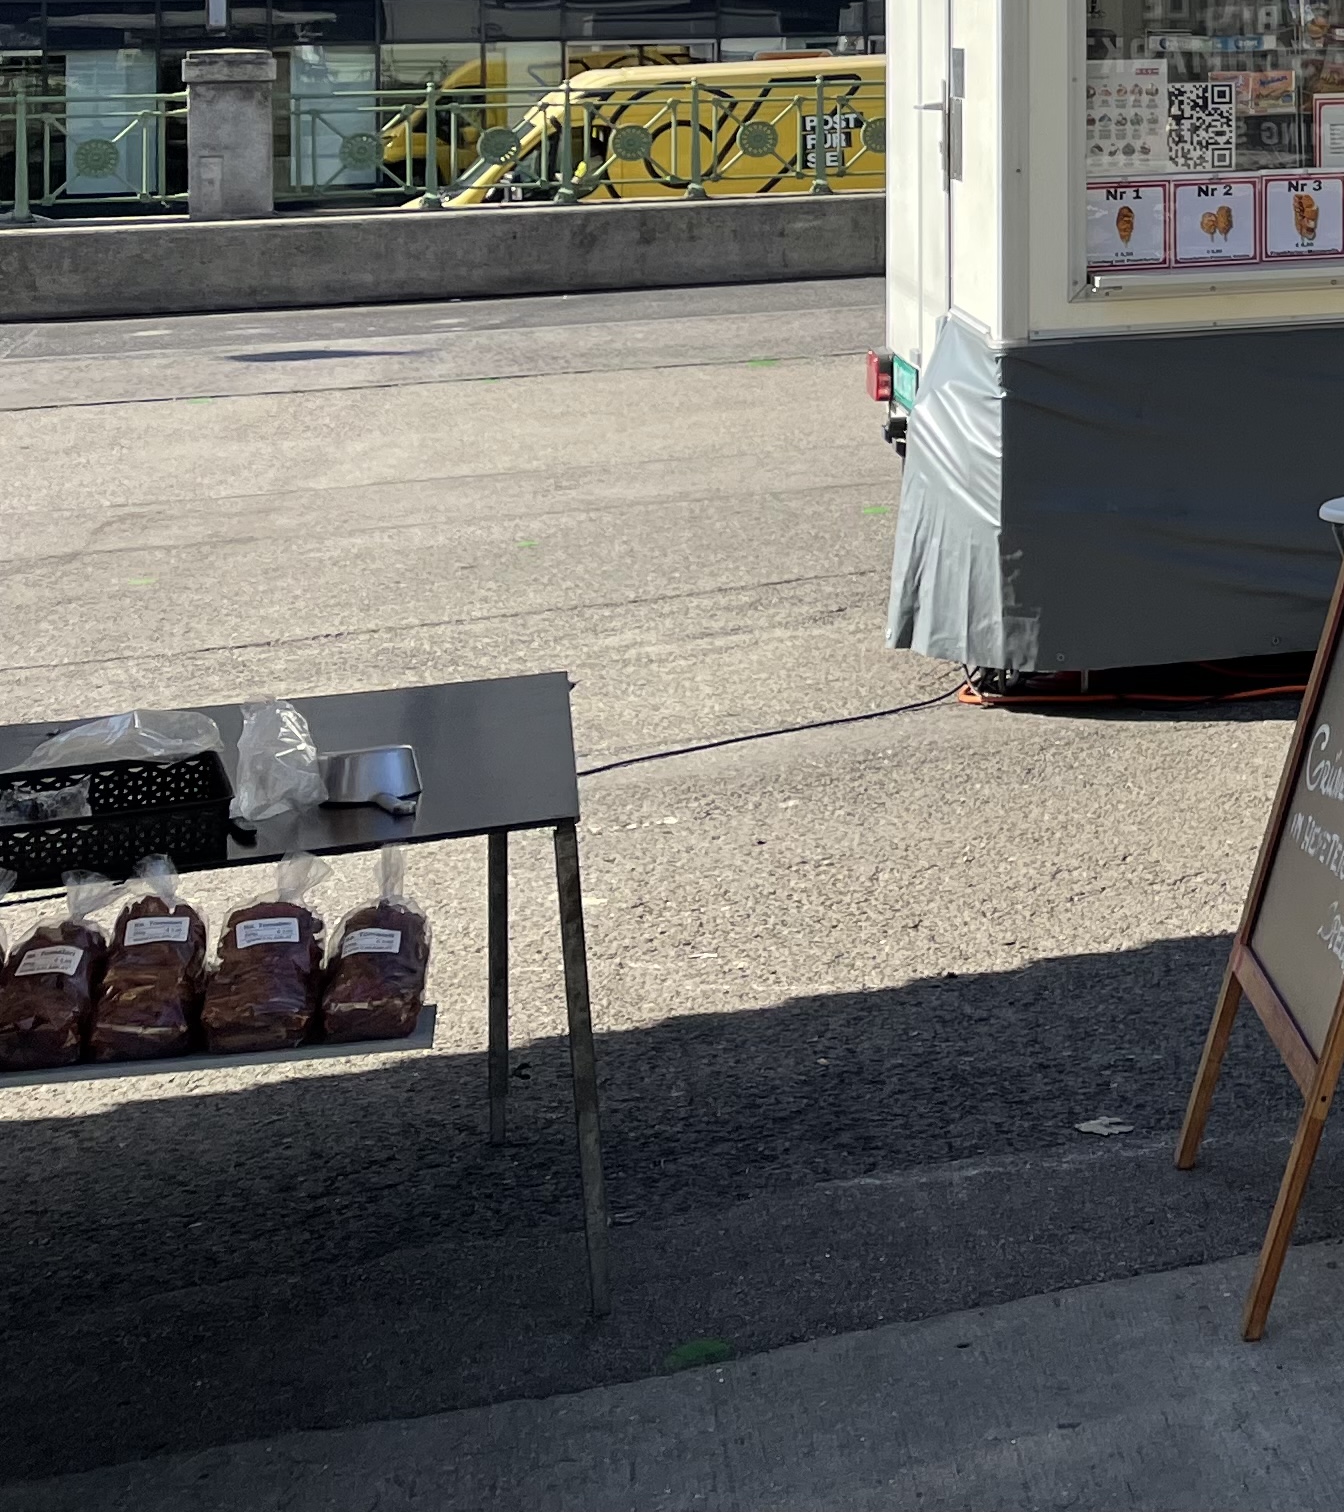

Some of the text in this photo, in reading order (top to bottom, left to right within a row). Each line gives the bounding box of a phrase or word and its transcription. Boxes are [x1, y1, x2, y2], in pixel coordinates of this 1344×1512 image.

[805, 113, 857, 131] POST
[806, 151, 839, 168] SE
[1197, 185, 1233, 197] Nr 2
[1287, 180, 1323, 192] Nr 3
[1105, 188, 1142, 201] Nr 1
